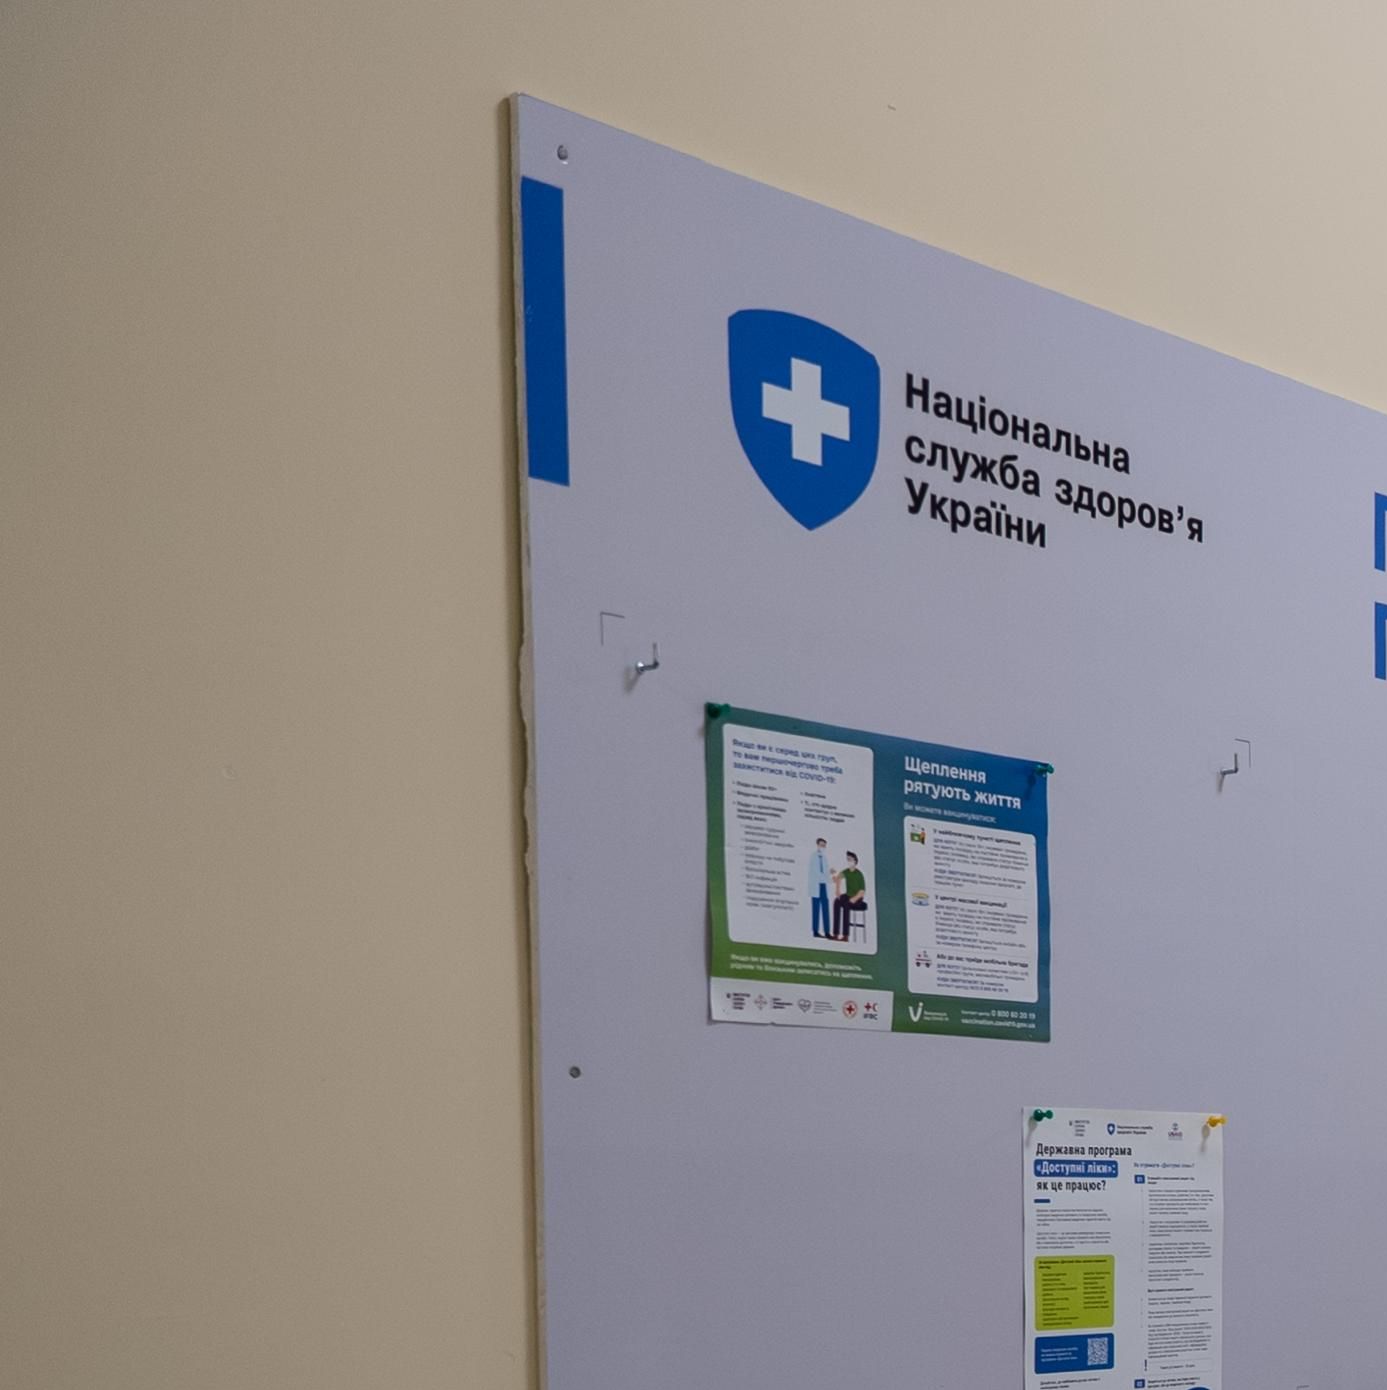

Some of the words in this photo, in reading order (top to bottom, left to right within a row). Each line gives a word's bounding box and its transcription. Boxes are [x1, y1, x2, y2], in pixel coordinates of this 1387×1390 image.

[905, 373, 1131, 475] Національна
[904, 433, 1041, 497] служба
[1054, 478, 1204, 543] здоров’я
[904, 478, 1047, 548] України
[904, 755, 987, 784] Щеплення
[904, 779, 972, 802] рятують
[974, 790, 1022, 810] життя
[1035, 1143, 1086, 1157] Державна
[1087, 1145, 1132, 1159] програма
[1036, 1161, 1085, 1176] «Доступні
[1036, 1181, 1049, 1191] як
[1051, 1181, 1064, 1194] це
[1065, 1180, 1107, 1194] працює?
